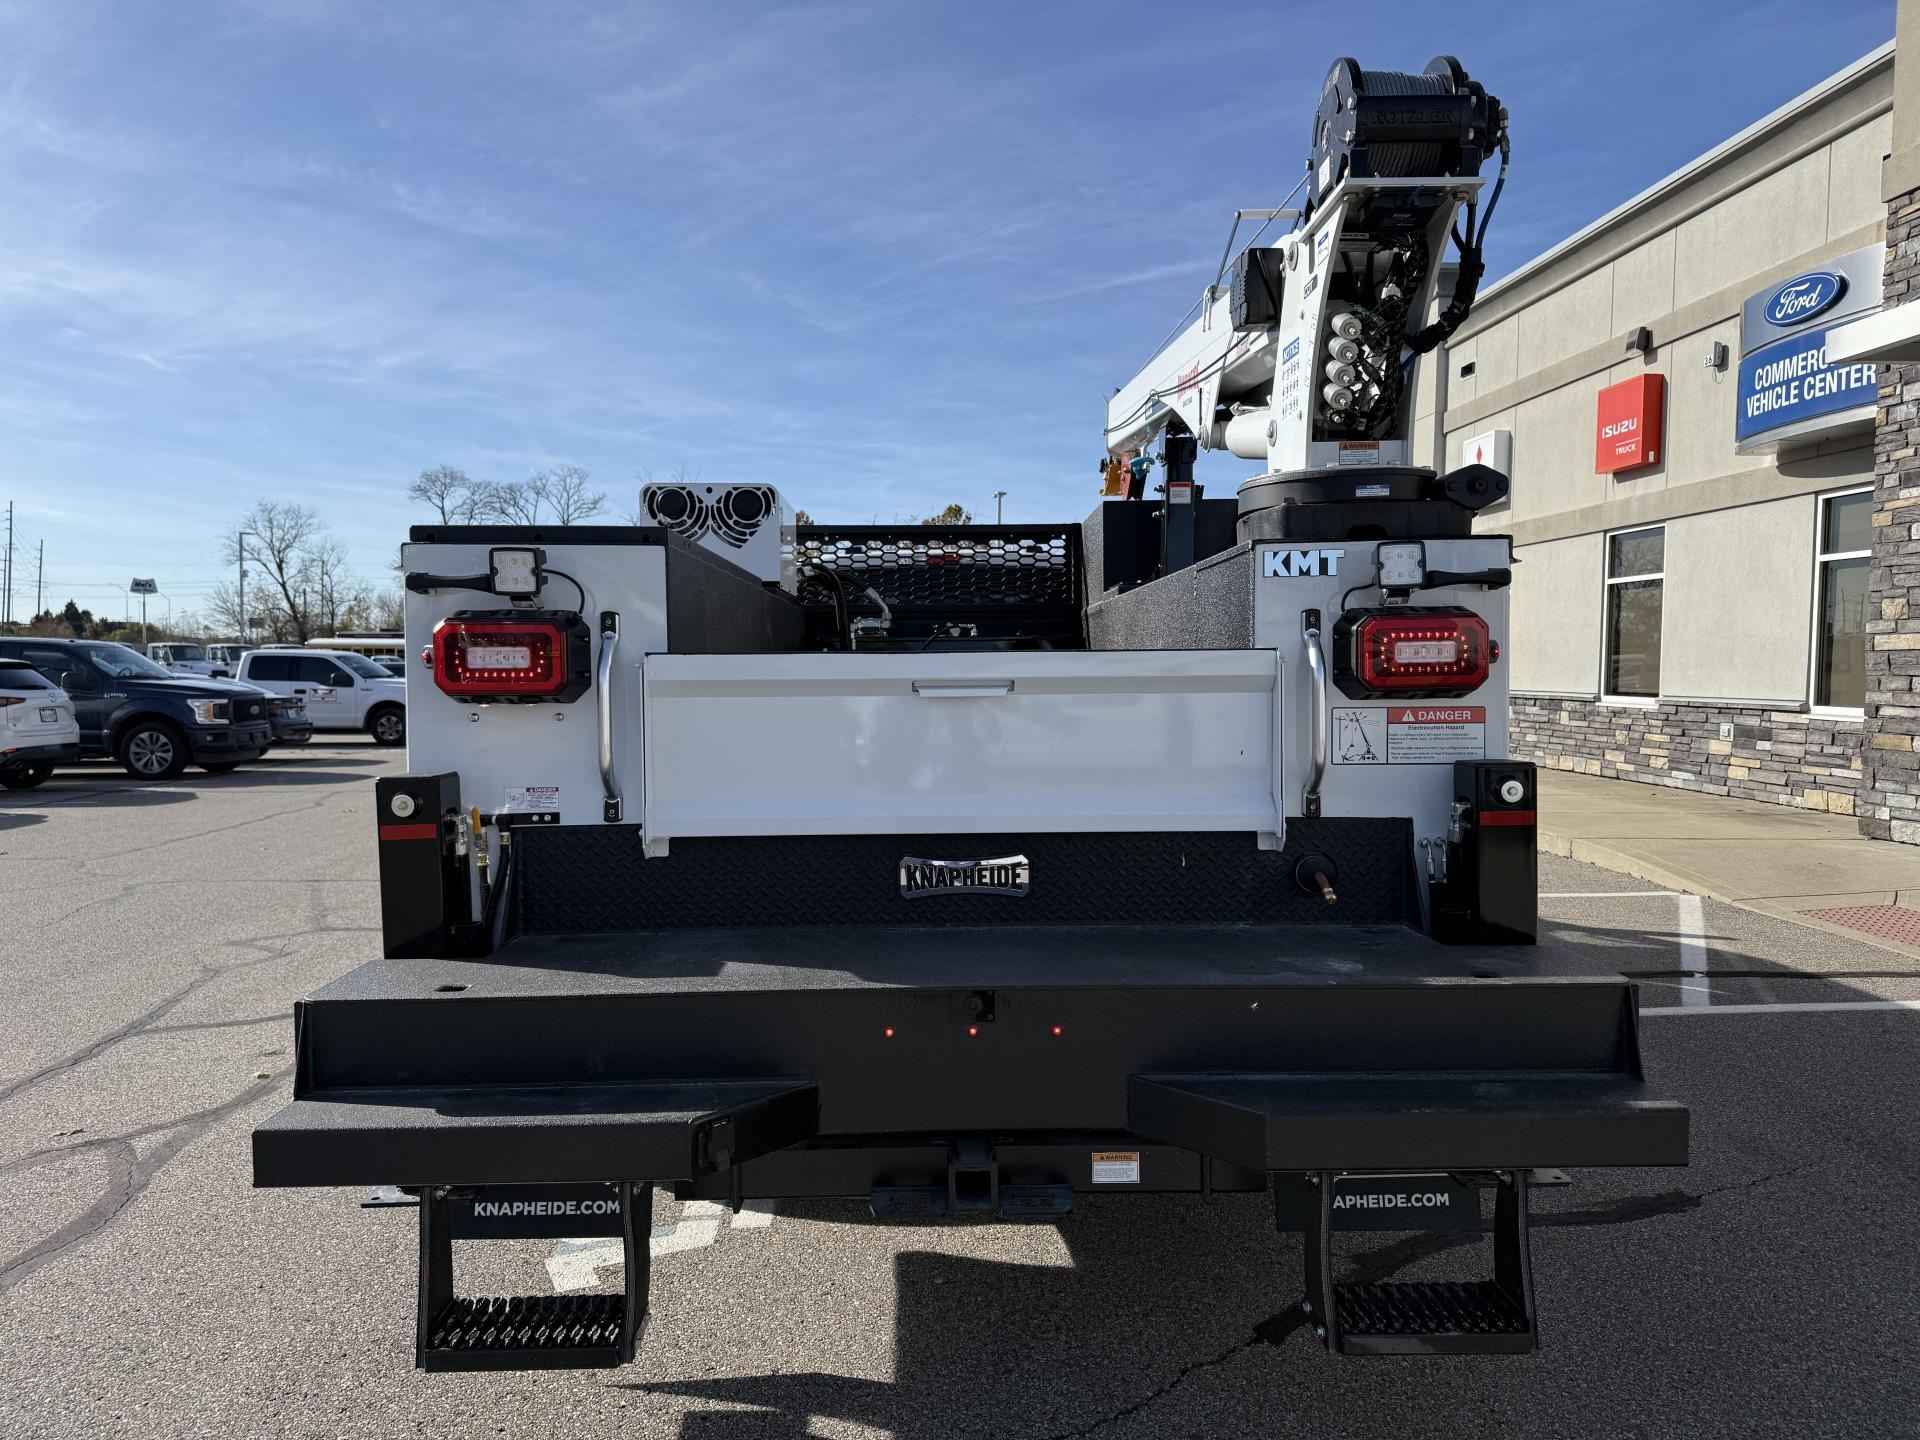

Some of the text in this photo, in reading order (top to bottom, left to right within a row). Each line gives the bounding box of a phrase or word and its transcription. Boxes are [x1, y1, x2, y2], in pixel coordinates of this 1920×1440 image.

[1372, 109, 1454, 124] ROTZLER
[1776, 282, 1822, 319] Ford
[1755, 345, 1828, 390] COMMERC
[1747, 363, 1876, 418] VEHICLE CENTER
[1601, 417, 1638, 439] ISUZU
[1615, 443, 1636, 456] TRUCK
[1263, 549, 1345, 578] KMT
[1418, 711, 1471, 720] DANGER
[905, 862, 1024, 893] KNAPHEIDE
[474, 1200, 621, 1217] KNAPHEIDE.COM
[1332, 1192, 1450, 1209] APHEIDE.COM
